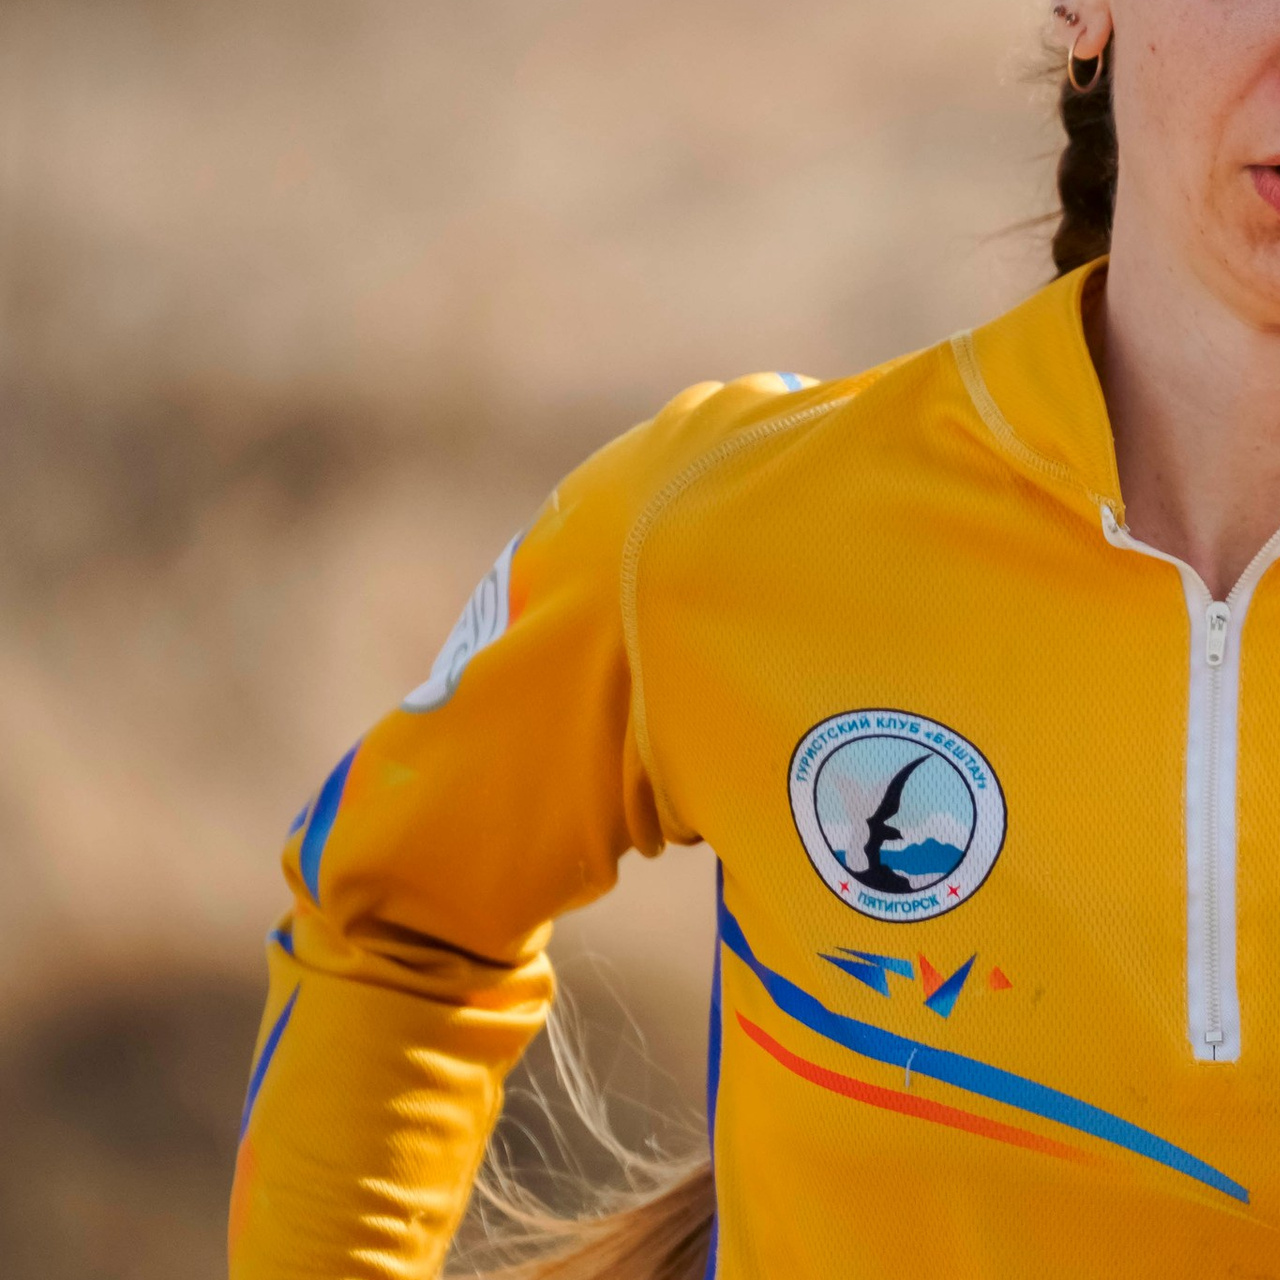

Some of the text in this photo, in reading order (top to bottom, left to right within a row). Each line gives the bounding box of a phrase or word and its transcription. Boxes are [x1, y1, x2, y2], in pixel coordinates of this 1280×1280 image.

[796, 715, 871, 782] ТУРИСТСКИЙ
[876, 717, 921, 734] КЛУБ
[857, 891, 941, 913] ПЯТИГОРСК
